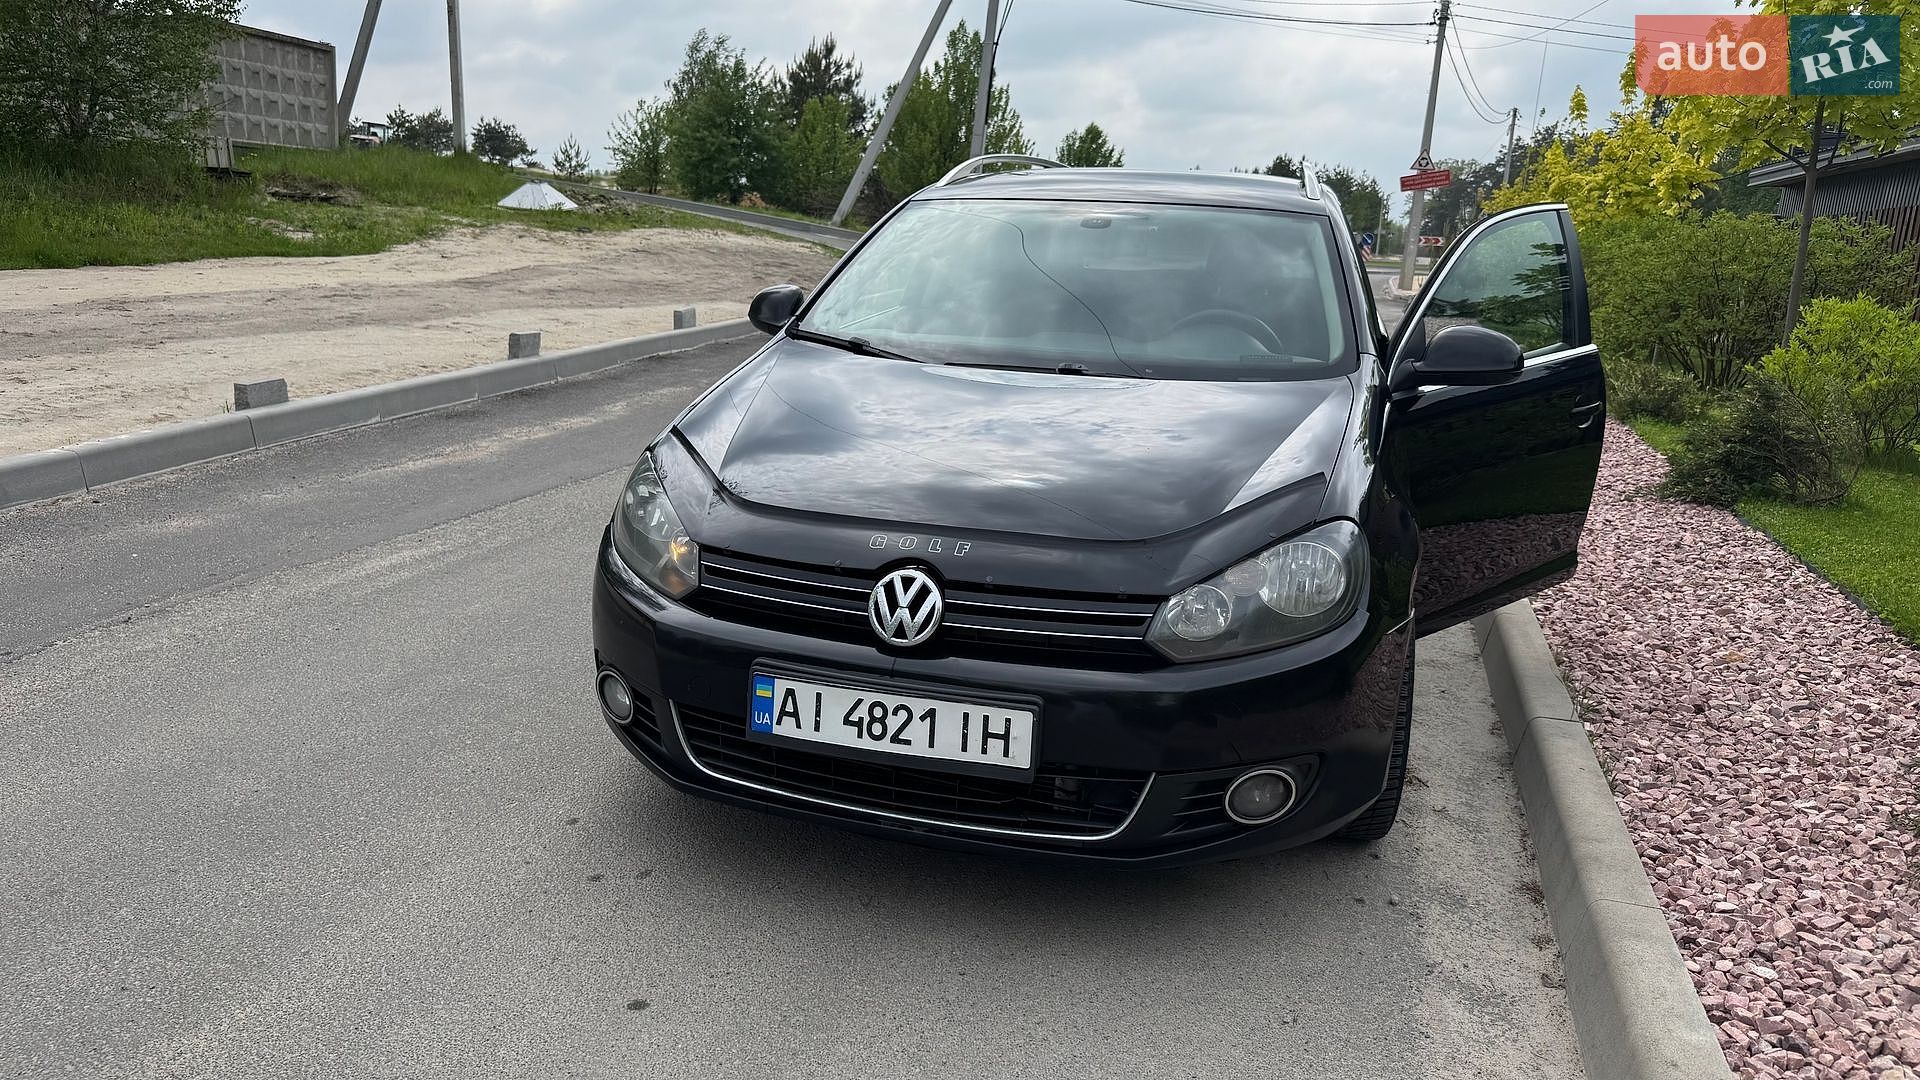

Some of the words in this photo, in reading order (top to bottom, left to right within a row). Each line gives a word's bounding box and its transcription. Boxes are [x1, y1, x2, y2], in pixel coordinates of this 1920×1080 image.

[869, 534, 971, 556] GOLF
[754, 711, 771, 725] UA
[775, 687, 822, 732] AI
[842, 697, 937, 749] 4821
[960, 711, 1012, 758] IH
